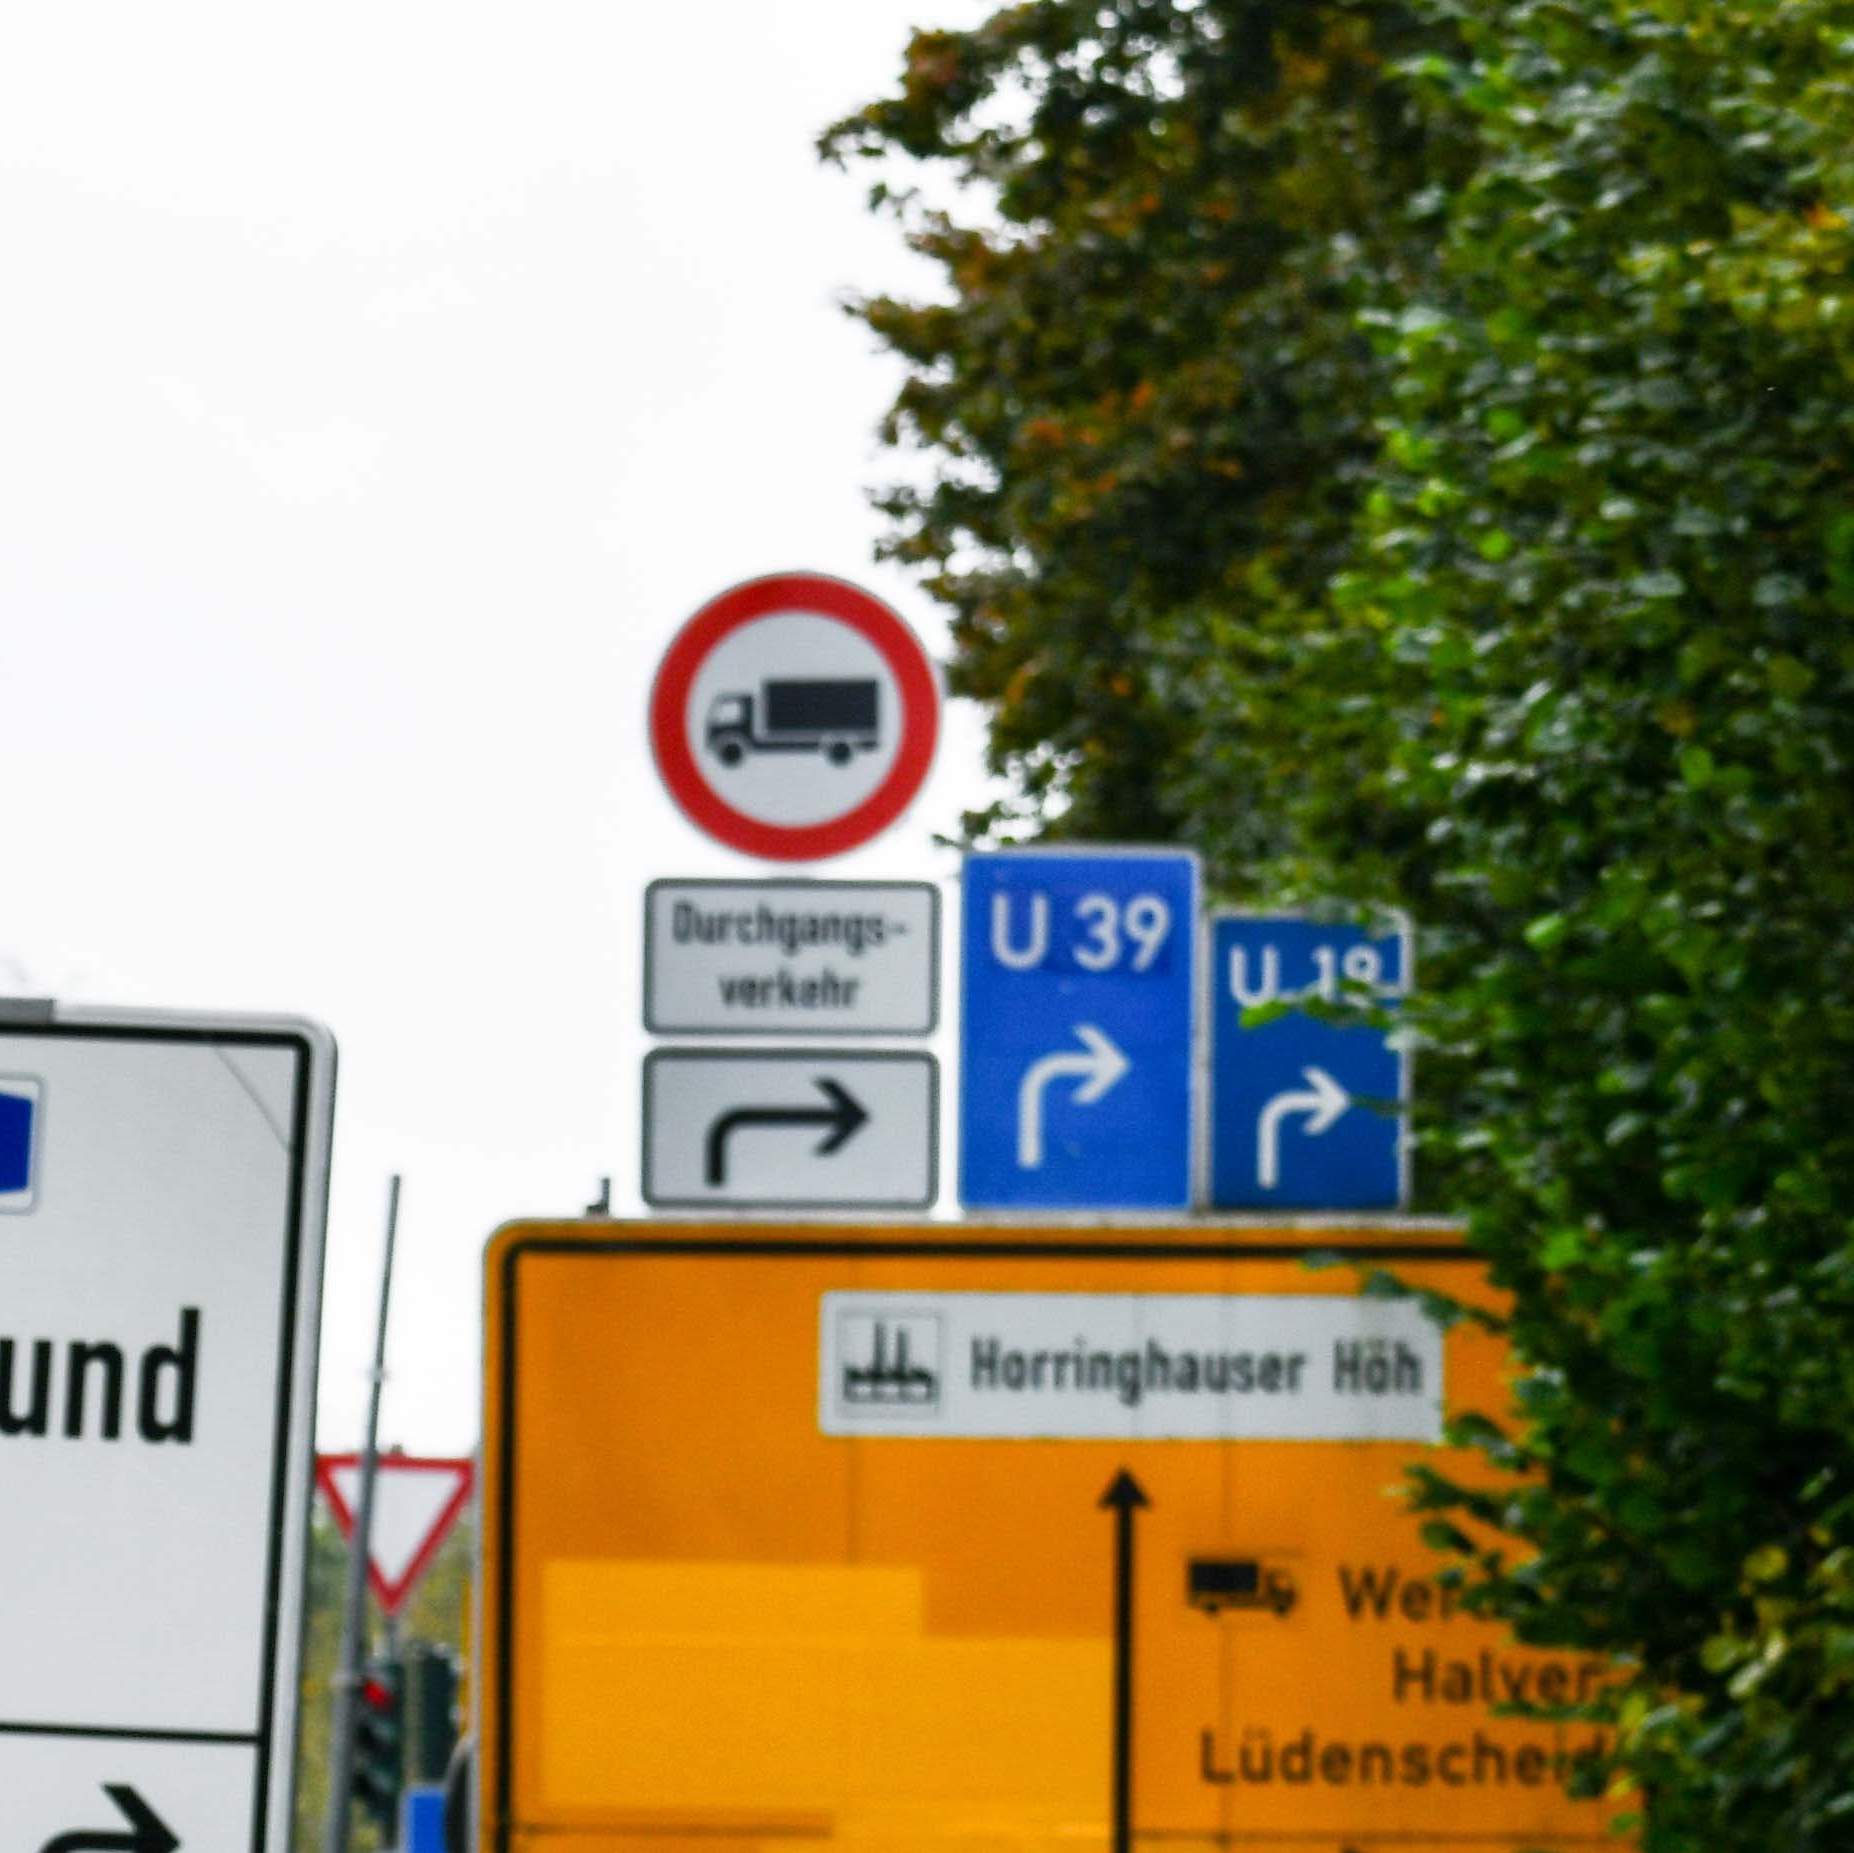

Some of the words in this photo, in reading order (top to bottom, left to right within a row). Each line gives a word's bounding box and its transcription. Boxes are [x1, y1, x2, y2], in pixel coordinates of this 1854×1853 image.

[673, 899, 909, 957] Durchgangs-
[990, 893, 1048, 972] U
[1073, 894, 1171, 974] 39
[718, 964, 859, 1007] verkehr
[1229, 943, 1280, 1007] U
[970, 1336, 1309, 1408] Horringhauser
